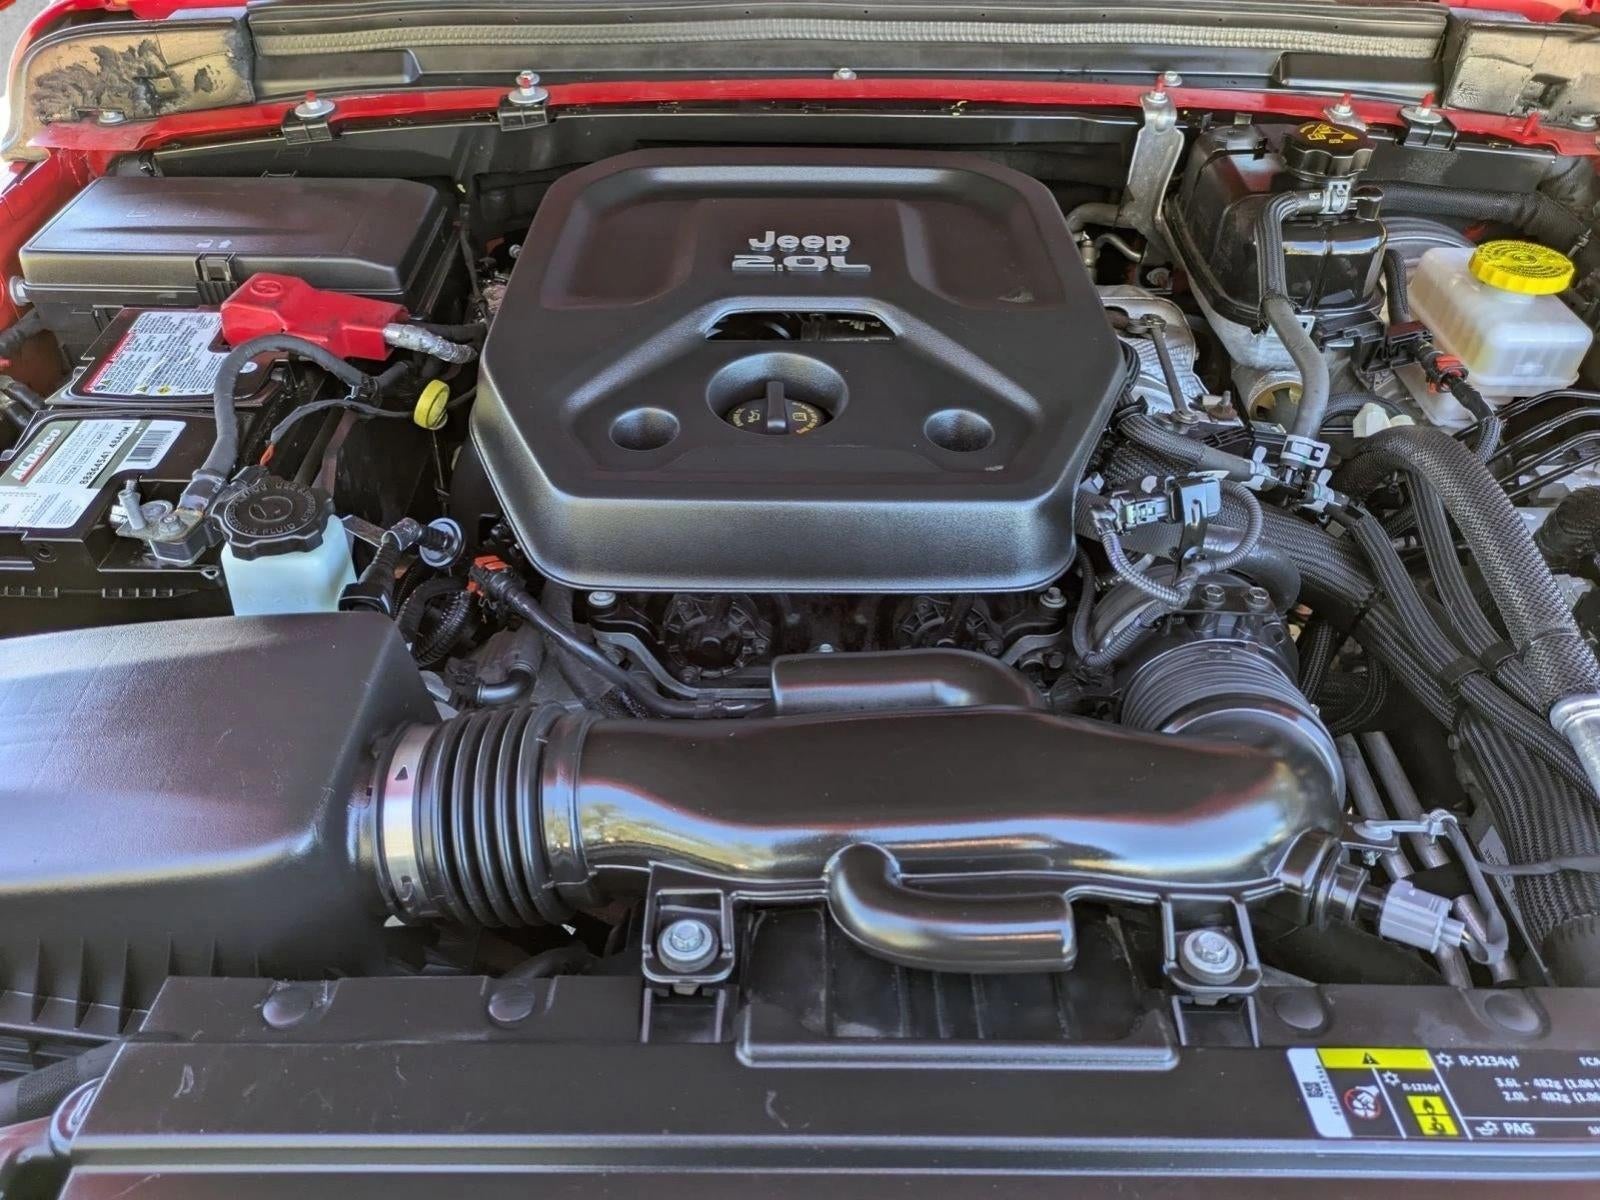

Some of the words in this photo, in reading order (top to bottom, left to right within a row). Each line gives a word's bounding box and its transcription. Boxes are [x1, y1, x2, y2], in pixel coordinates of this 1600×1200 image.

[748, 231, 851, 252] Jeep
[732, 254, 871, 272] 2.0L
[11, 428, 61, 480] ACDelco
[1459, 1055, 1520, 1069] R-1234yf
[1503, 1122, 1535, 1136] PAG
